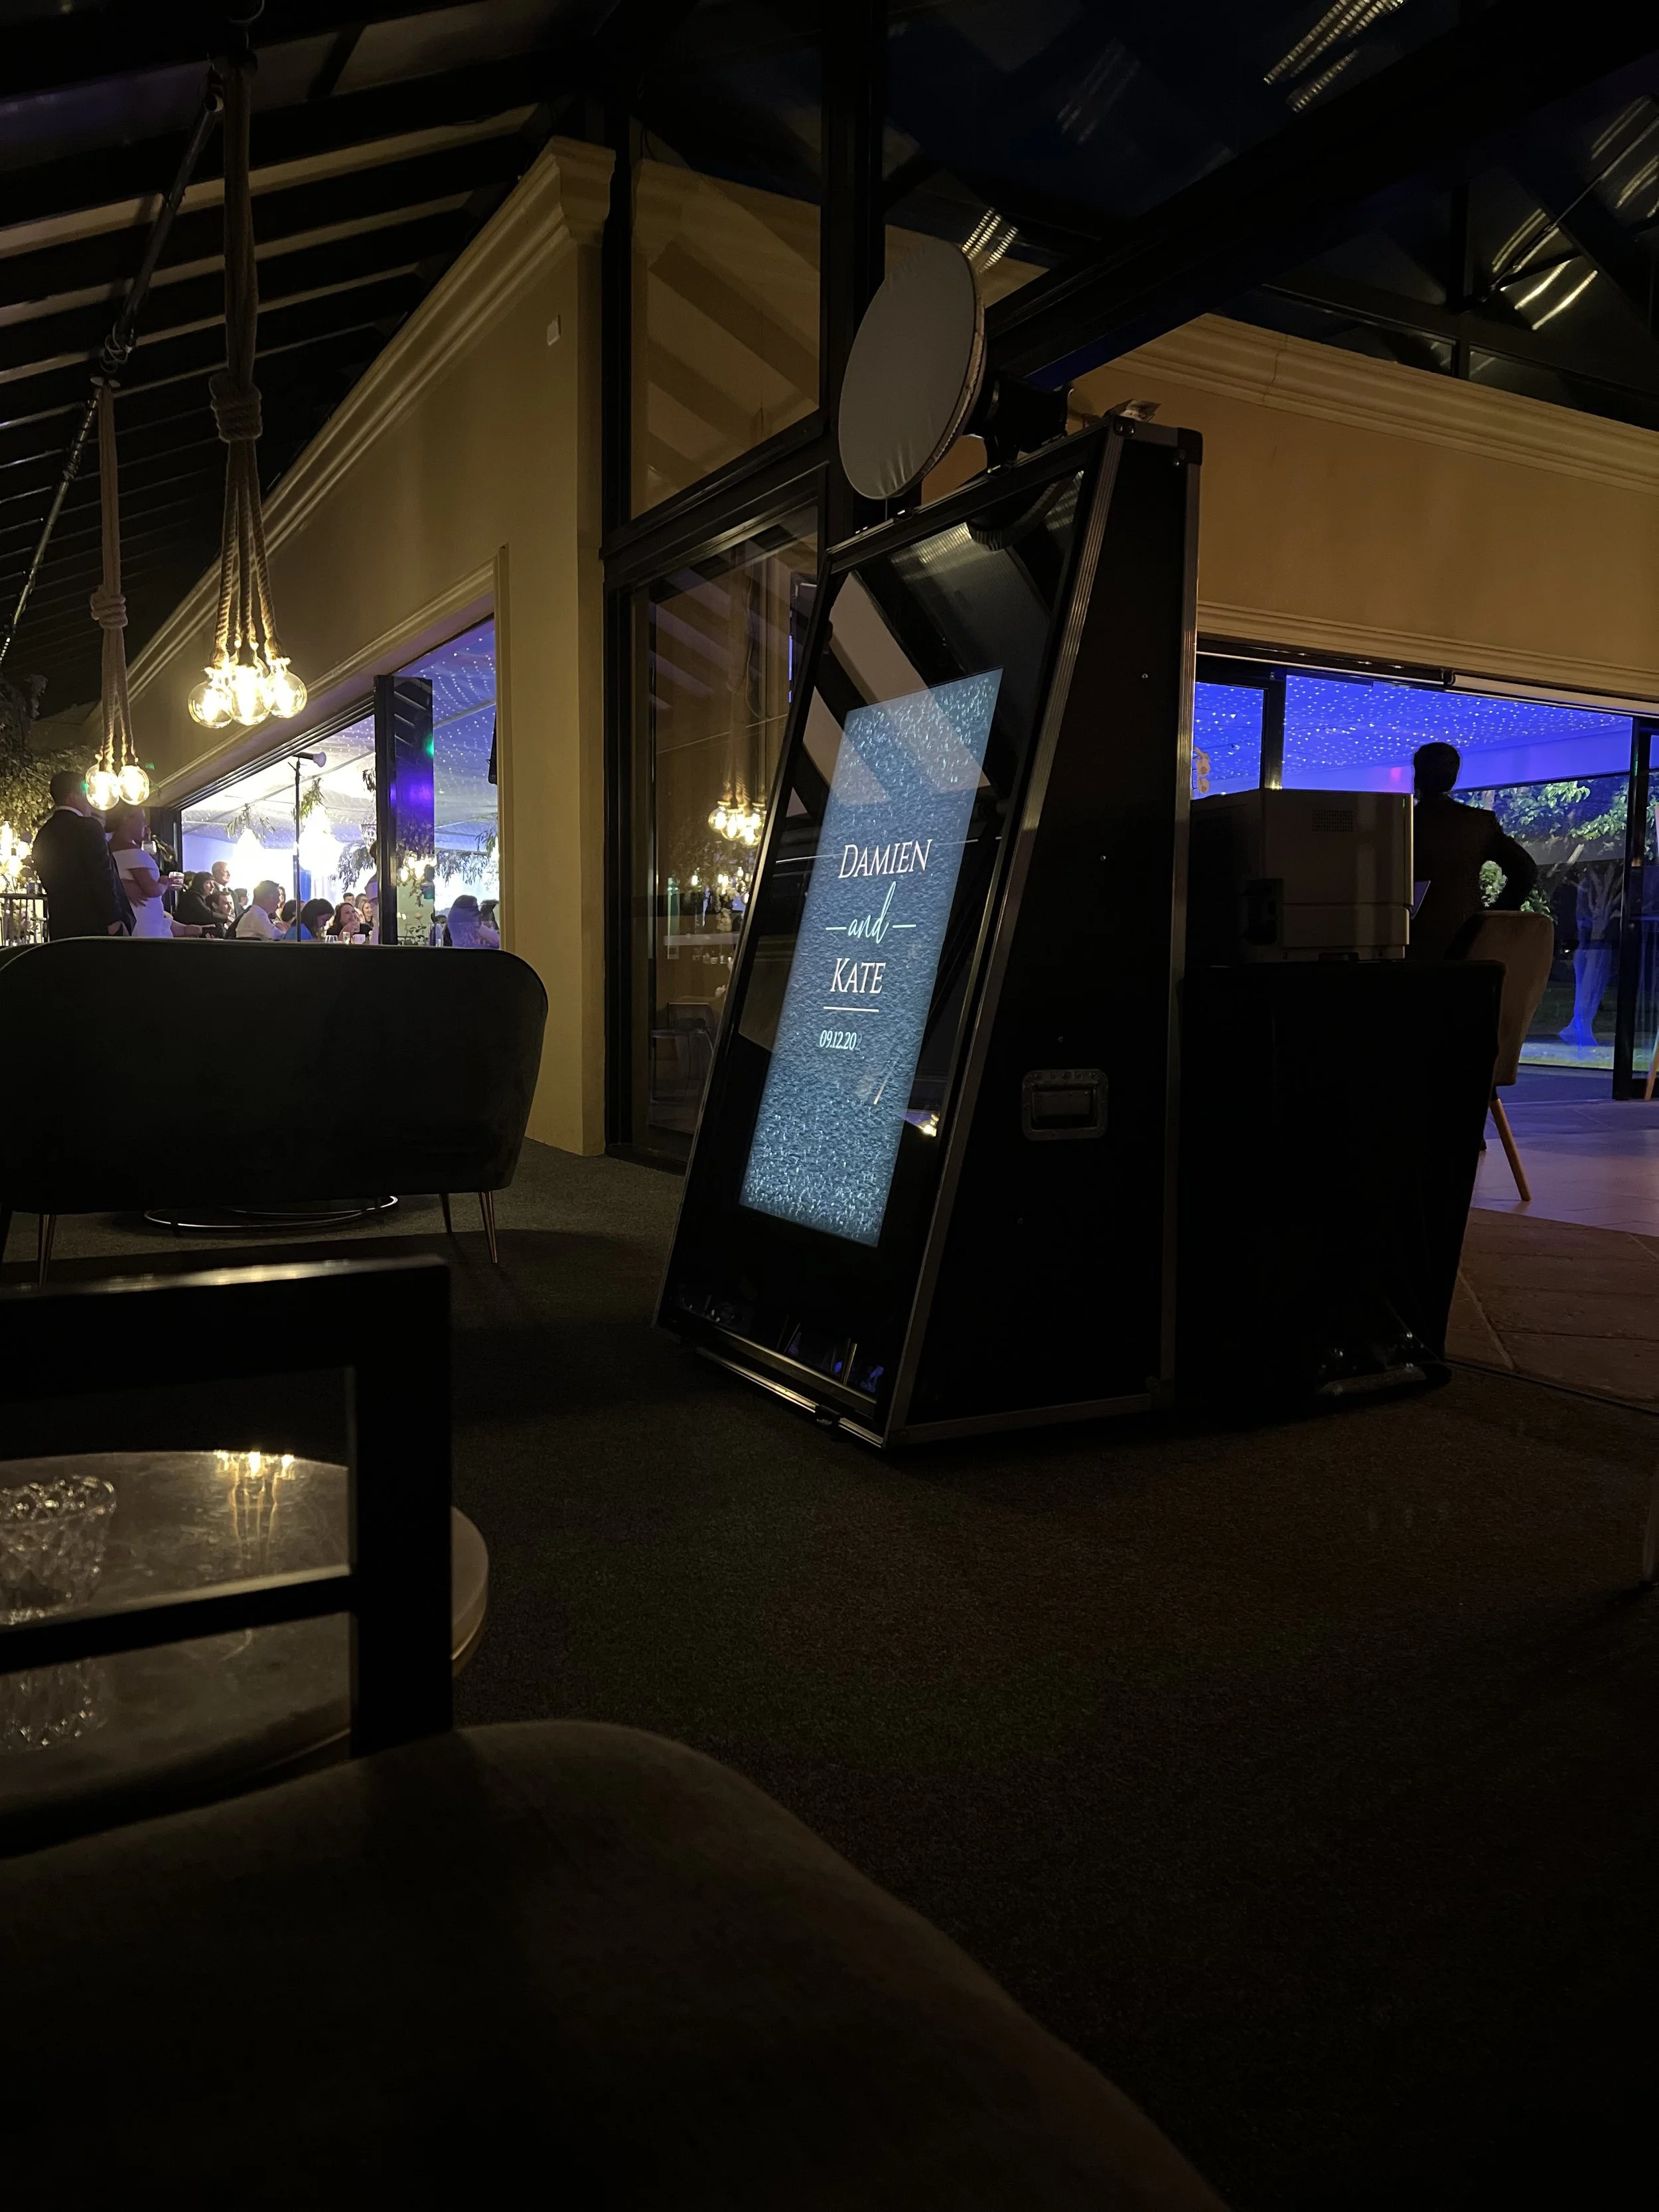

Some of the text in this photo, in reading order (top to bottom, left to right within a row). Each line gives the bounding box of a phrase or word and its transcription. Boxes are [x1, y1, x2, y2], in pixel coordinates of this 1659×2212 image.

[837, 838, 933, 879] DAMIEN
[847, 881, 897, 944] and
[830, 957, 887, 994] KATE
